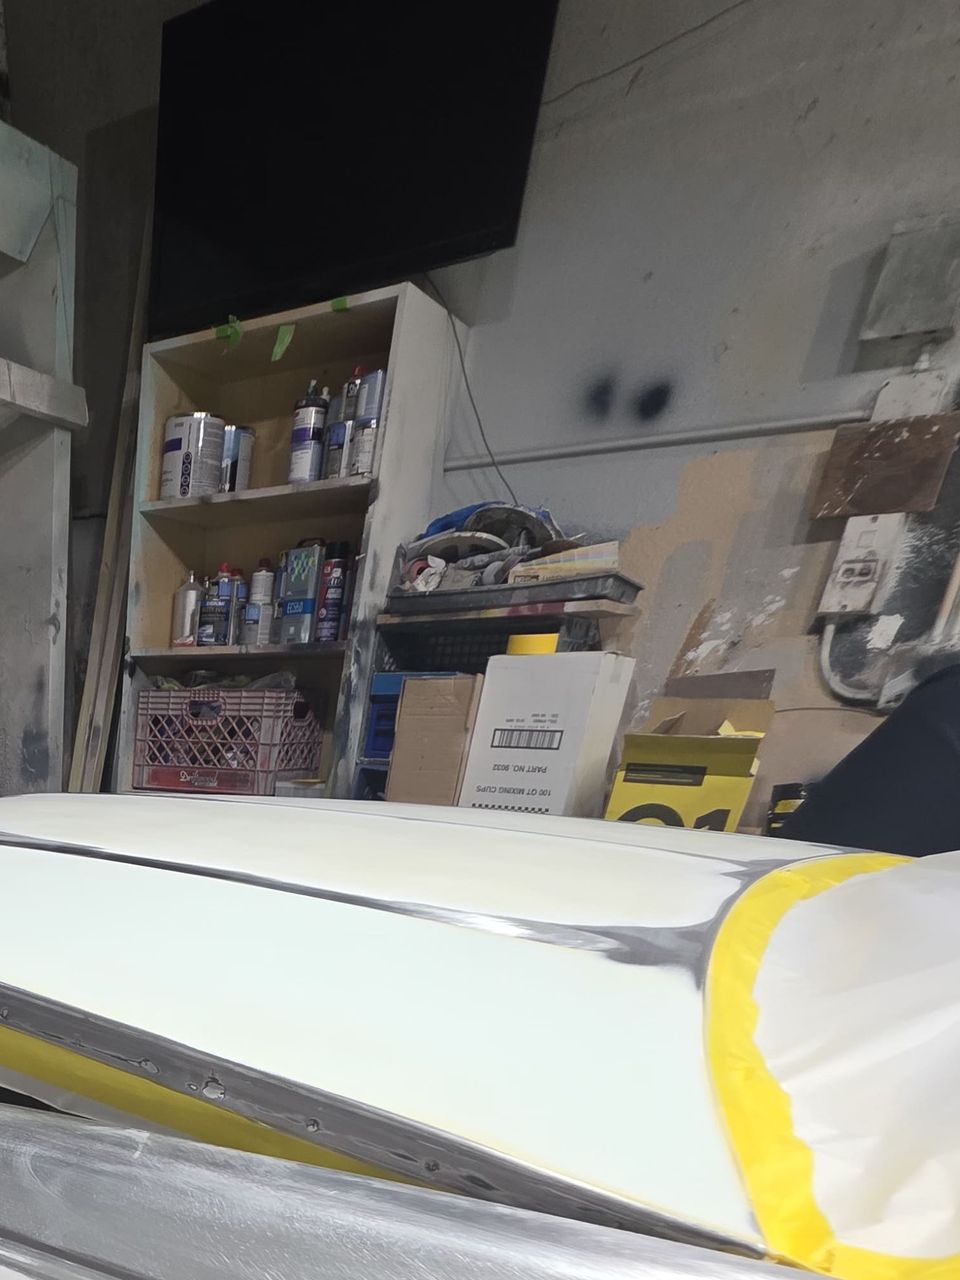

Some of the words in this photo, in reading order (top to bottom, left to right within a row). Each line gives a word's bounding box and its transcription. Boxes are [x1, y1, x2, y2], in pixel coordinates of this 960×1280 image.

[493, 763, 510, 771] 9032
[512, 764, 525, 772] NO.
[526, 765, 548, 773] PART
[476, 785, 497, 793] CUPS
[498, 786, 525, 795] MIXING
[526, 788, 538, 796] QT
[539, 788, 551, 796] 100
